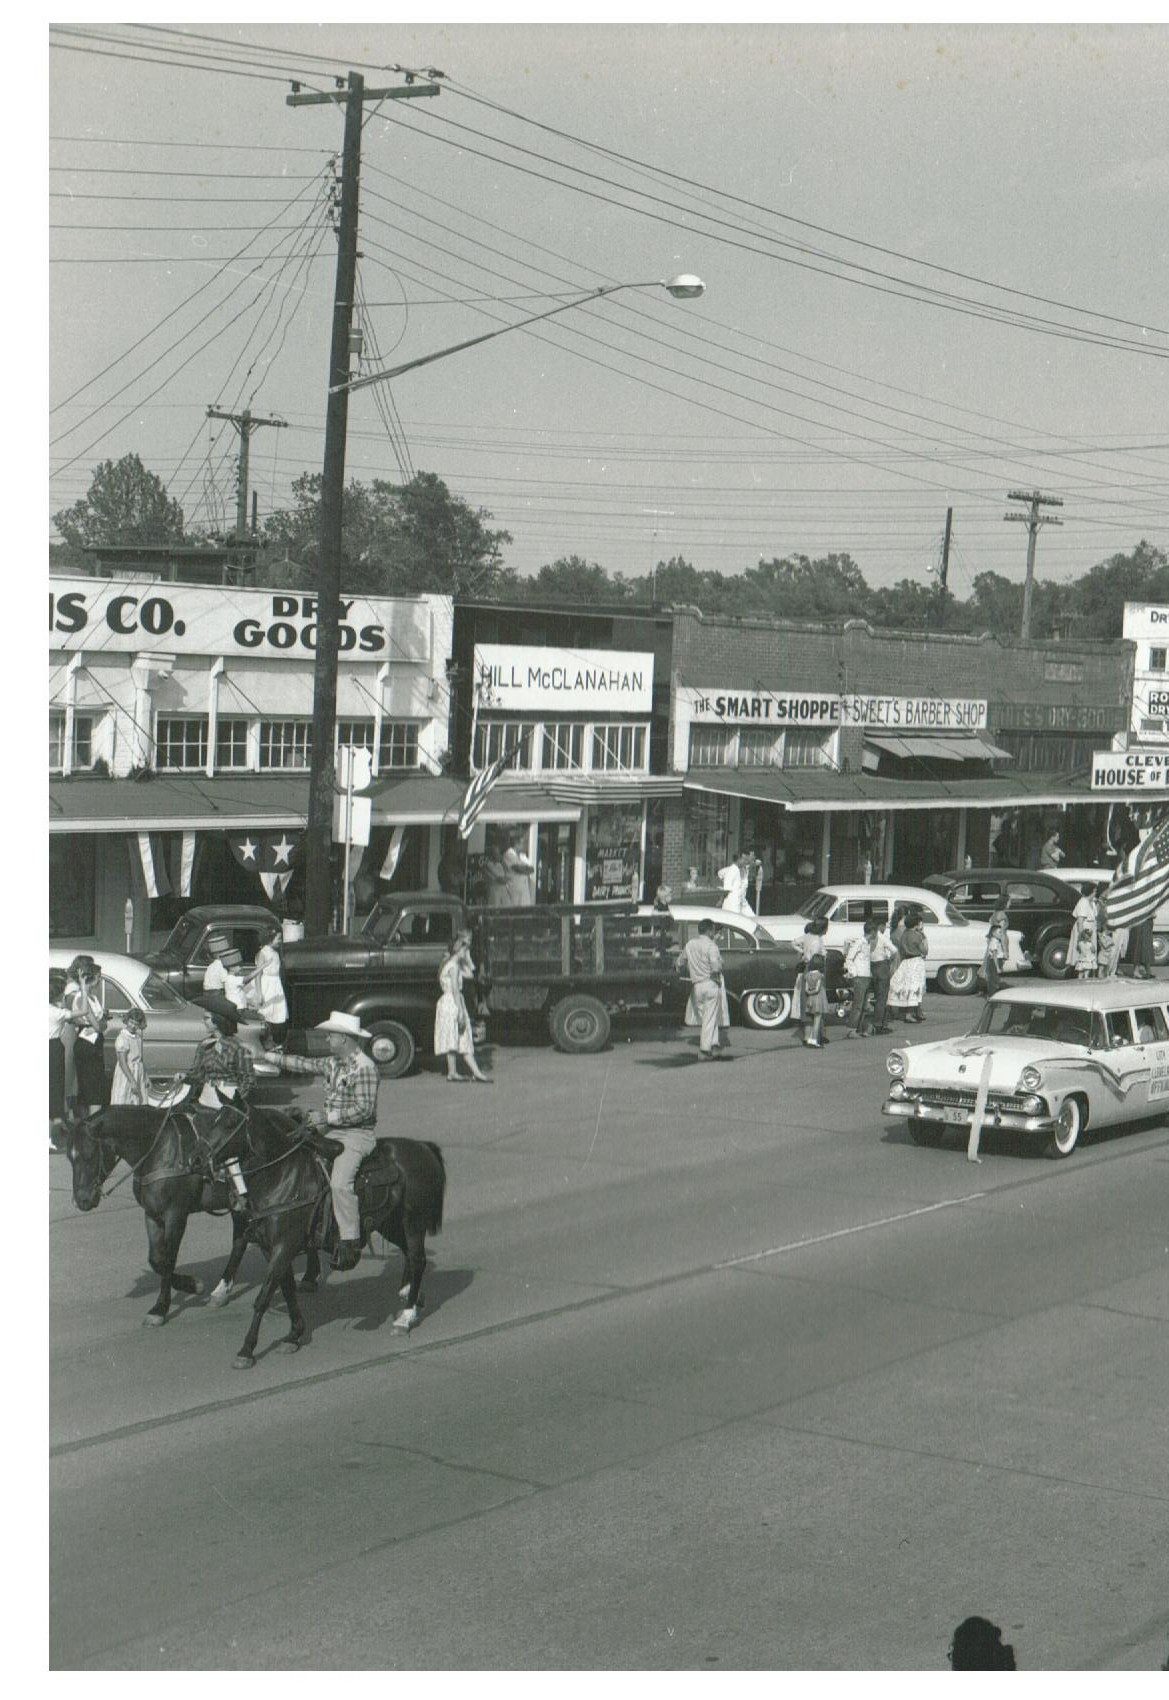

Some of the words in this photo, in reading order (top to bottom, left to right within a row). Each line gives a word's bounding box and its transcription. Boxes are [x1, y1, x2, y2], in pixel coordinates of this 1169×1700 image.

[49, 592, 88, 633] S
[106, 596, 186, 637] CO.
[481, 665, 522, 688] HILL
[694, 698, 710, 713] THE
[715, 697, 772, 718] SMART
[777, 700, 839, 720] SHOPPE
[853, 697, 900, 724] SWEET'S
[905, 701, 951, 725] BARBER
[955, 703, 985, 725] SHOP
[1095, 769, 1145, 786] HOUSE
[1150, 771, 1162, 782] OF
[598, 848, 628, 858] MARKET
